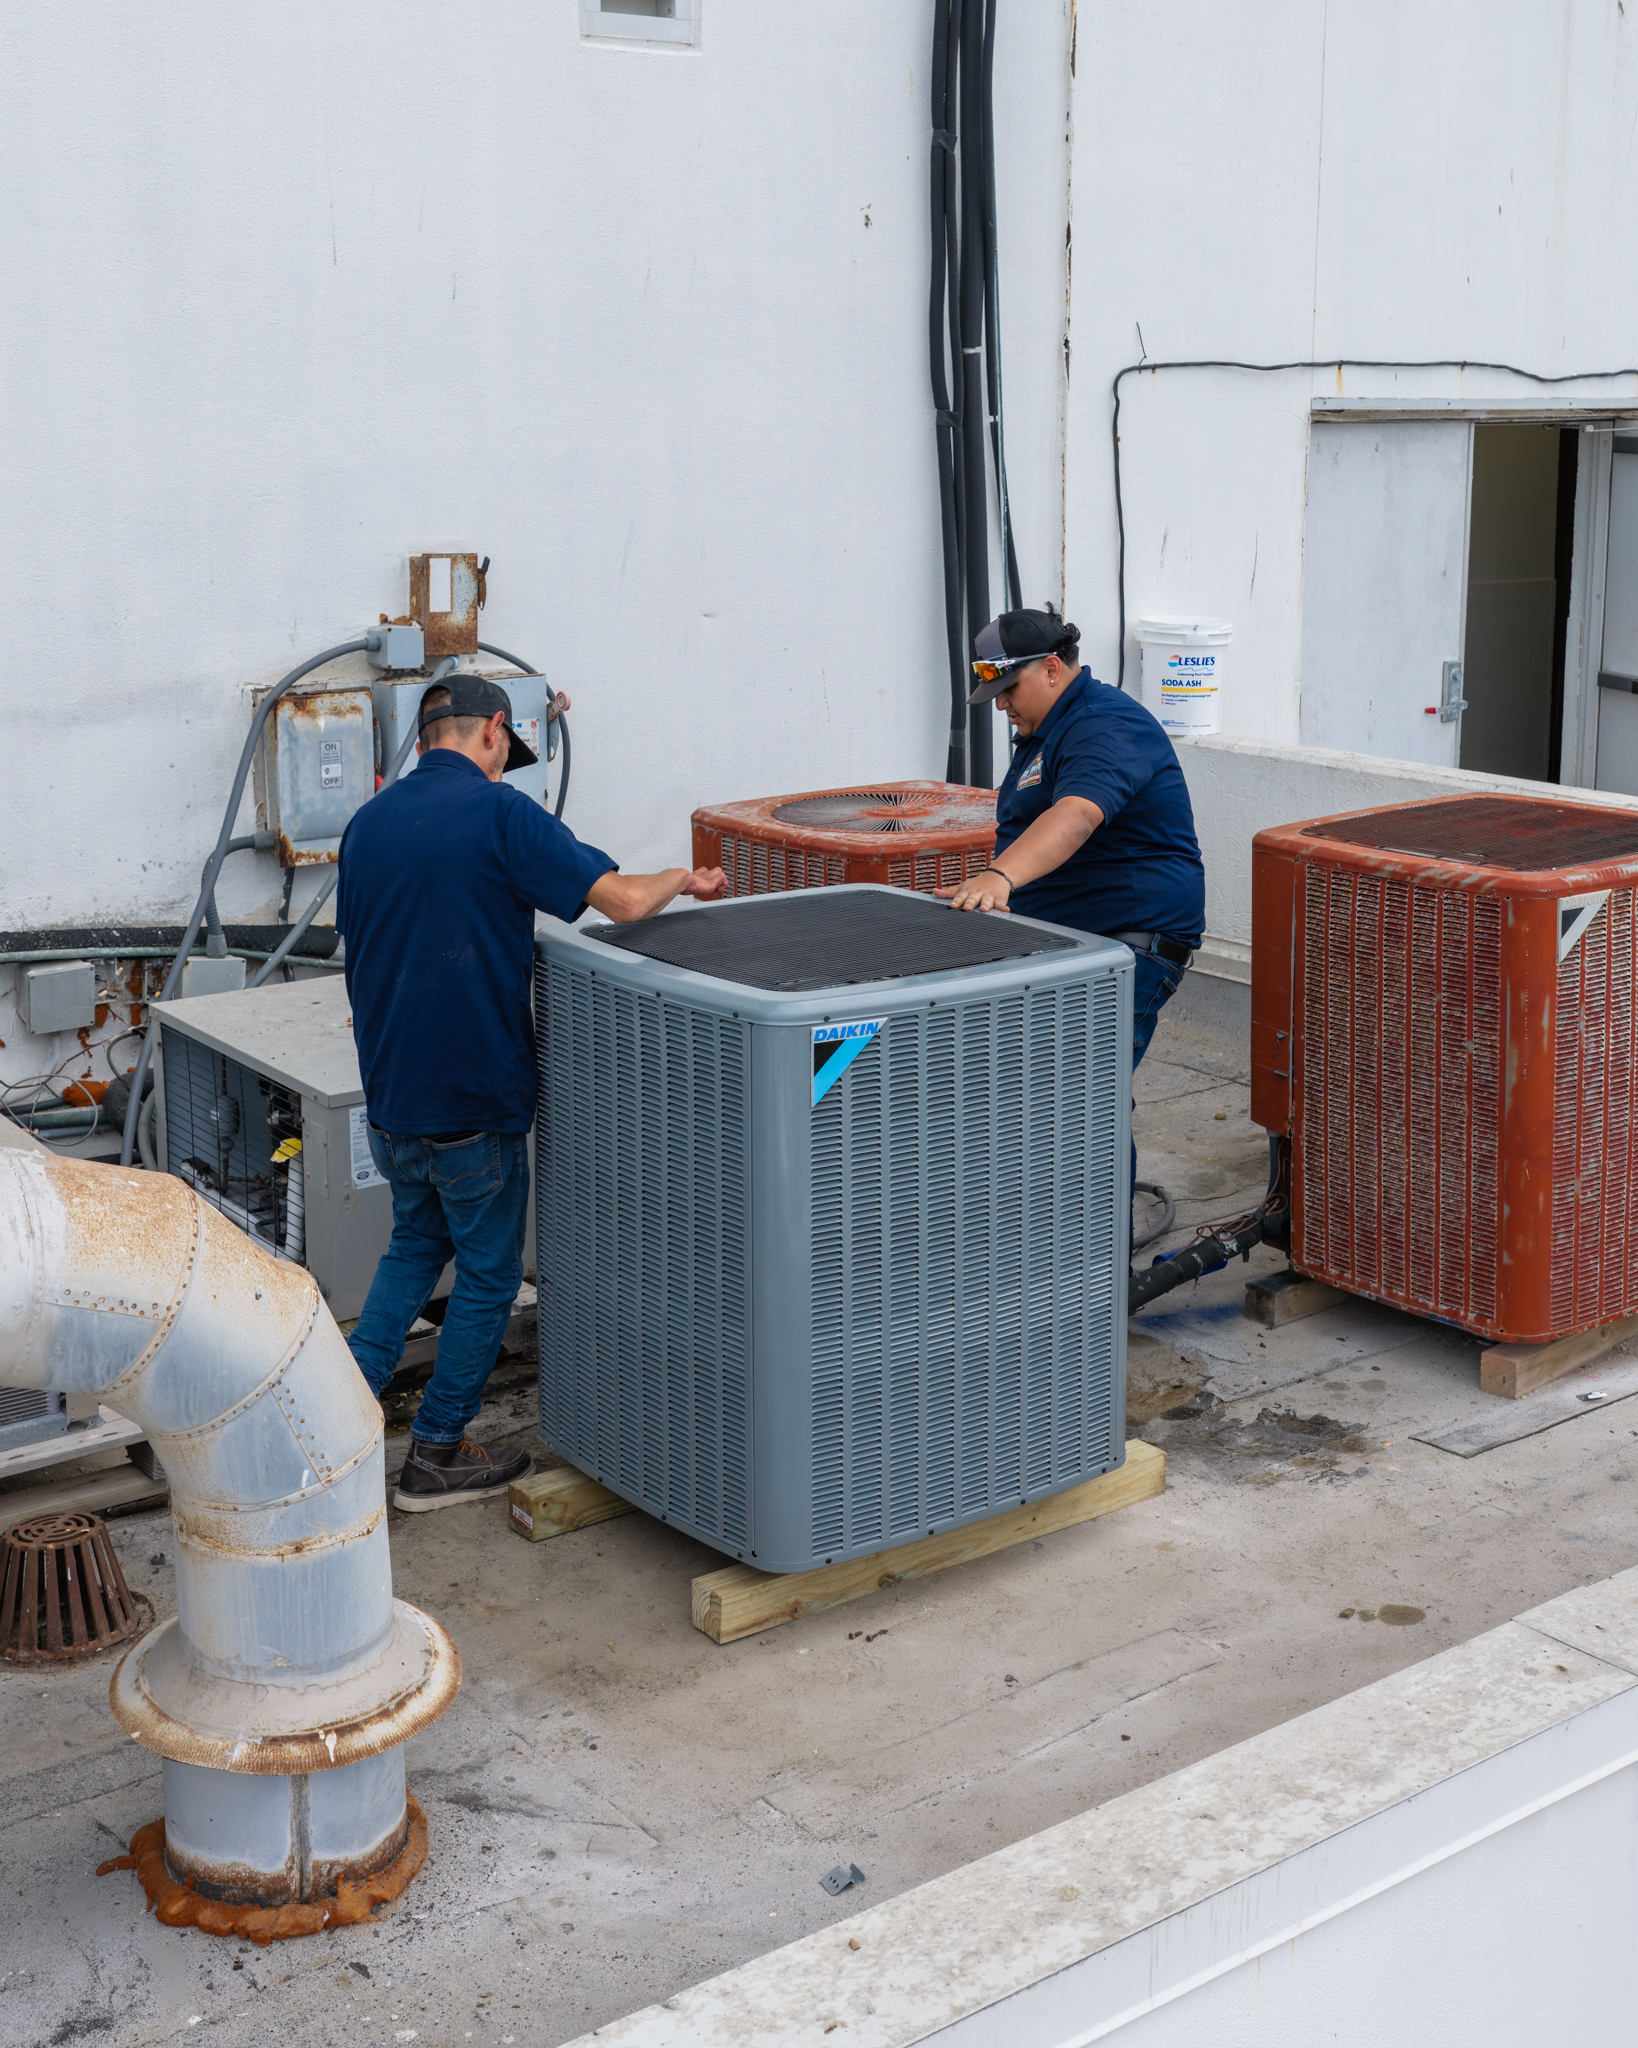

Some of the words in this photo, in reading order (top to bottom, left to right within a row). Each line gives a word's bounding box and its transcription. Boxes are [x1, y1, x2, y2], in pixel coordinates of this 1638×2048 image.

[1161, 678, 1184, 687] SODA
[1185, 679, 1202, 687] ASH
[324, 743, 337, 751] ON
[323, 777, 340, 786] OFF
[1562, 891, 1606, 909] DAIKIN
[814, 1022, 879, 1042] DAIKIN
